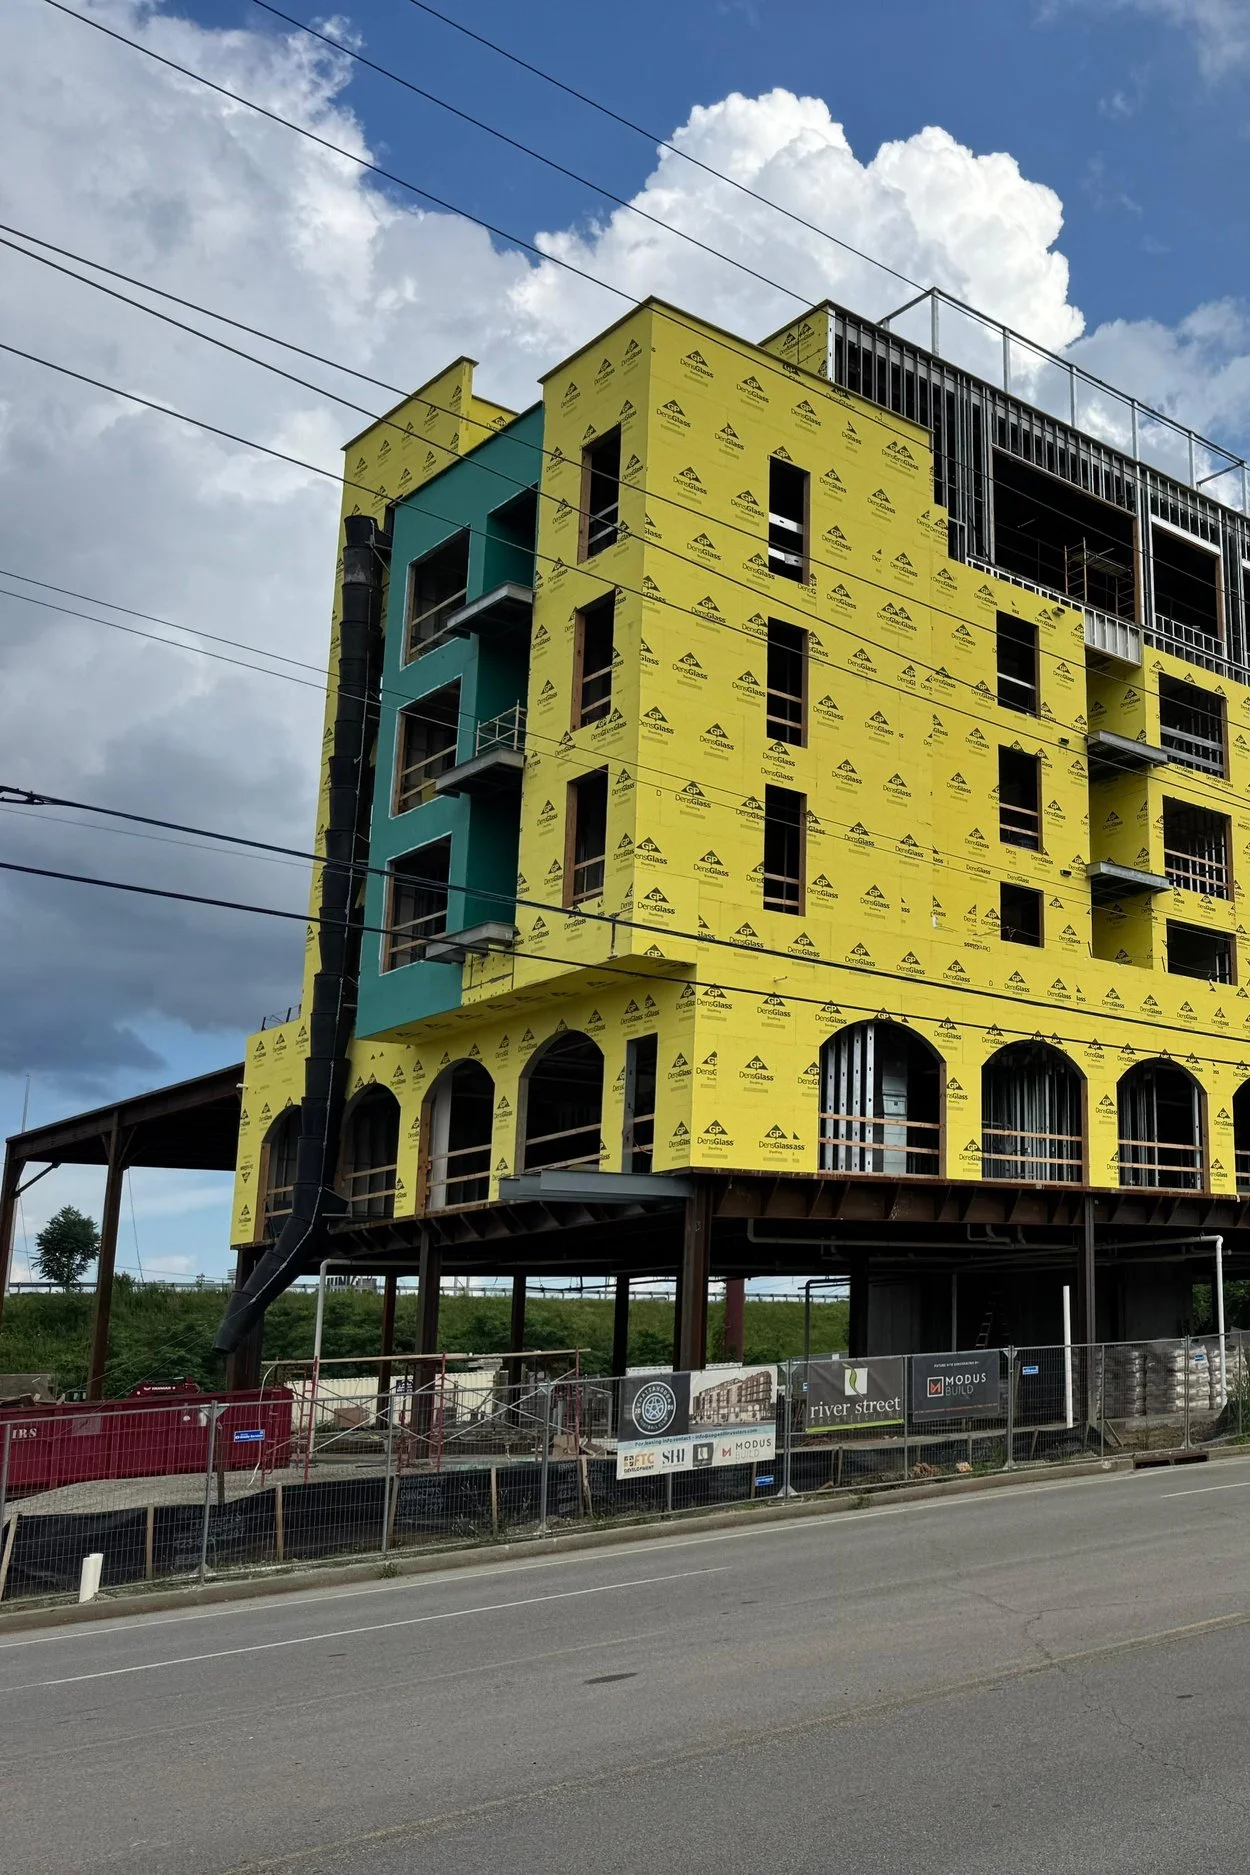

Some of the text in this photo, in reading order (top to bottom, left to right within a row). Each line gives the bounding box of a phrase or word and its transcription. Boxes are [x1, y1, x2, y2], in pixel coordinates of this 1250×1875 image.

[680, 359, 714, 378] DensGlass
[737, 384, 769, 403] DensGlass
[657, 409, 691, 428] DensGlass
[791, 408, 821, 426] DensGlass
[673, 476, 707, 495] DensGlass
[820, 477, 847, 494] DensGlass
[731, 499, 764, 518] DensGlass
[867, 498, 896, 514] DensGlass
[822, 535, 852, 551] DensGlass
[687, 543, 721, 561] DensGlass
[742, 563, 775, 579] DensGlass
[890, 562, 918, 578] DensGlass
[827, 593, 857, 609] DensGlass
[952, 633, 976, 647] DensGlass
[672, 664, 708, 680] DensGlass
[848, 658, 877, 674] DensGlass
[732, 682, 766, 697] DensGlass
[813, 705, 844, 721] DensGlass
[865, 721, 894, 736] DensGlass
[700, 735, 734, 750] DensGlass
[966, 737, 990, 750] DensGlass
[762, 752, 795, 767] DensGlass
[761, 767, 794, 782] DensGlass
[832, 770, 862, 785] DensGlass
[883, 784, 912, 798] DensGlass
[946, 782, 971, 794] DensGlass
[675, 794, 711, 809] DensGlass
[965, 837, 989, 849] DensGlass
[895, 846, 924, 858] DensGlass
[694, 864, 729, 877] DensGlass
[807, 887, 838, 899] DensGlass
[638, 902, 675, 914] DensGlass
[860, 898, 890, 909] DensGlass
[788, 947, 820, 958] DensGlass
[845, 956, 876, 966] DensGlass
[896, 964, 925, 975] DensGlass
[943, 972, 970, 983] DensGlass
[1004, 983, 1030, 993] DensGlass
[1047, 990, 1071, 1000] DensGlass
[697, 998, 732, 1010] DensGlass
[1102, 1000, 1124, 1009] DensGlass
[757, 1006, 791, 1017] DensGlass
[815, 1014, 847, 1025] DensGlass
[668, 1069, 692, 1080] DensGlass
[739, 1071, 774, 1081] DensGlass
[697, 1137, 734, 1146] DensGlass
[759, 1141, 792, 1149] DensGlass
[945, 1373, 987, 1385] MODUS
[945, 1385, 974, 1396] BUILD
[810, 1401, 850, 1418] river
[855, 1396, 901, 1414] street
[735, 1438, 772, 1450] MODUS
[635, 1453, 655, 1466] FTC
[662, 1448, 685, 1464] SHI
[735, 1450, 759, 1460] BUILD
